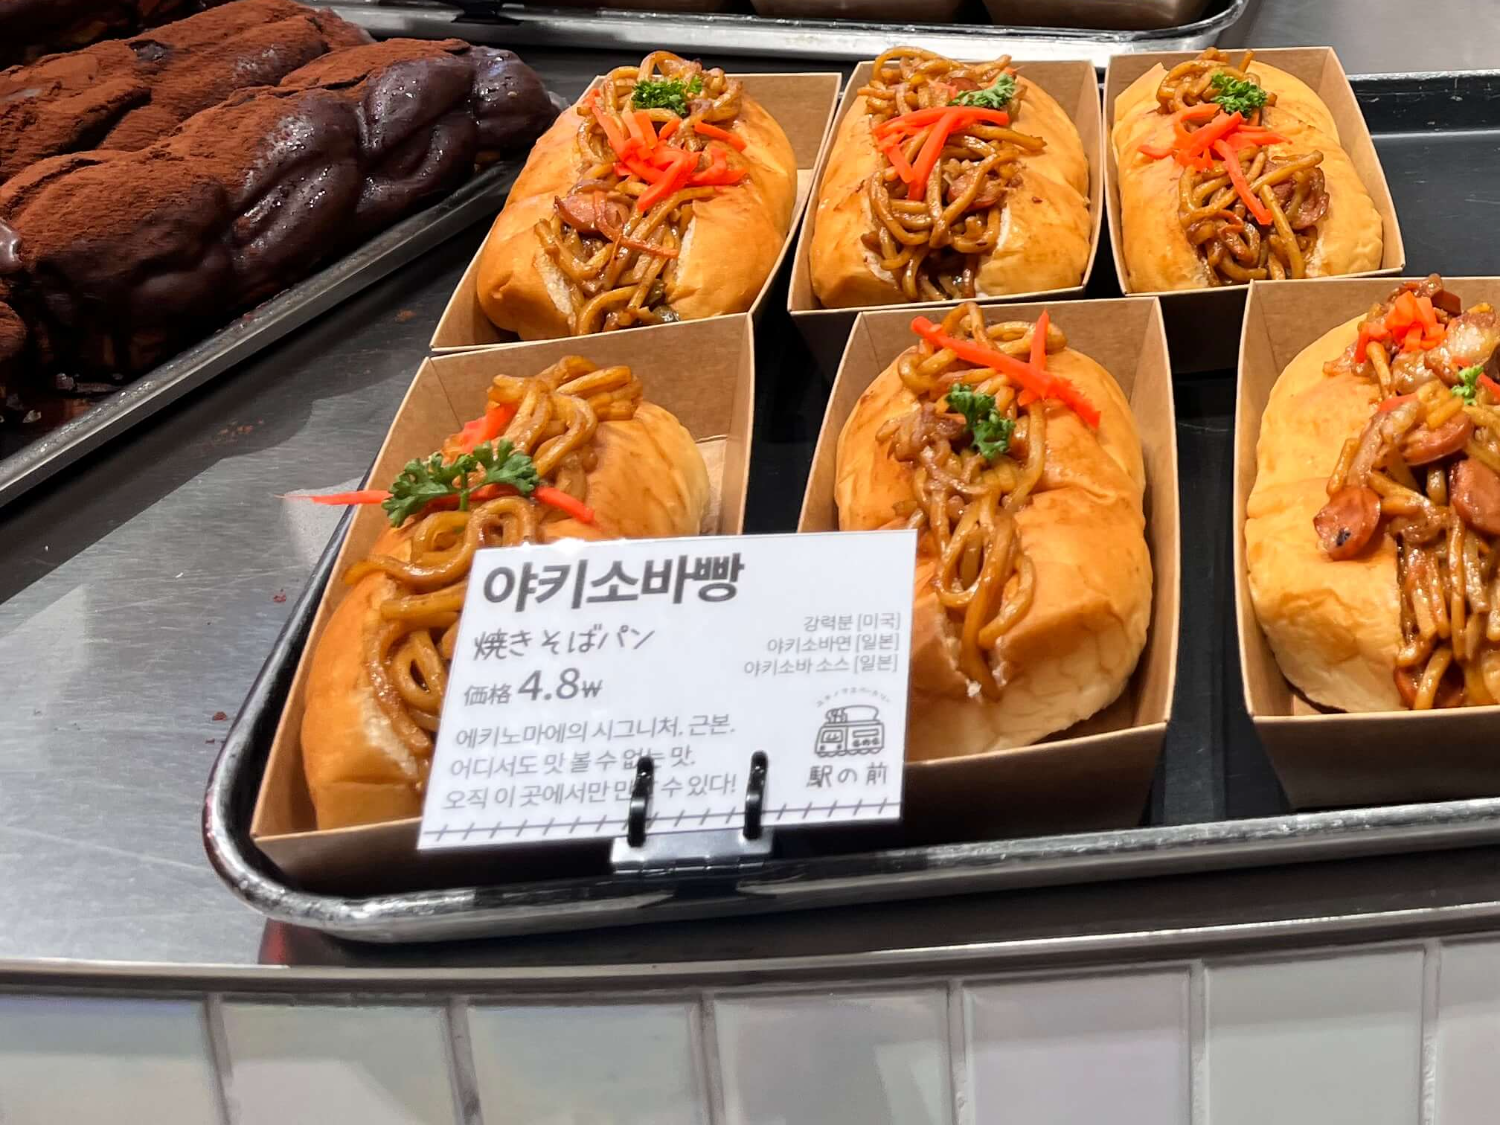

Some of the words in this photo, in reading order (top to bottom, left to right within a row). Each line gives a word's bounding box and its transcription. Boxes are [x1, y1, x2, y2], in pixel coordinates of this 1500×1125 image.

[483, 552, 744, 612] 야키소바빵
[803, 614, 853, 633] 강력분
[856, 612, 901, 632] [미국]
[473, 623, 656, 661] 焼きそばパン
[766, 634, 852, 655] 야키소바면
[855, 632, 900, 654] [일본]
[743, 658, 813, 678] 야키소바
[815, 656, 850, 673] 소스
[853, 654, 899, 675] [일본]
[463, 683, 512, 707] 価格
[455, 720, 589, 750] 에키노마에의
[689, 713, 736, 737] 근본.
[450, 752, 540, 781] 어디서도
[543, 752, 567, 775] 맛
[570, 750, 592, 773] 볼
[595, 751, 618, 772] 수
[670, 743, 696, 768] 맛.
[805, 761, 889, 789] 駅の前
[442, 786, 489, 811] 오직
[493, 786, 516, 809] 이
[518, 779, 611, 808] 곳에서만
[660, 776, 684, 798] 수
[686, 773, 737, 799] 있다!
